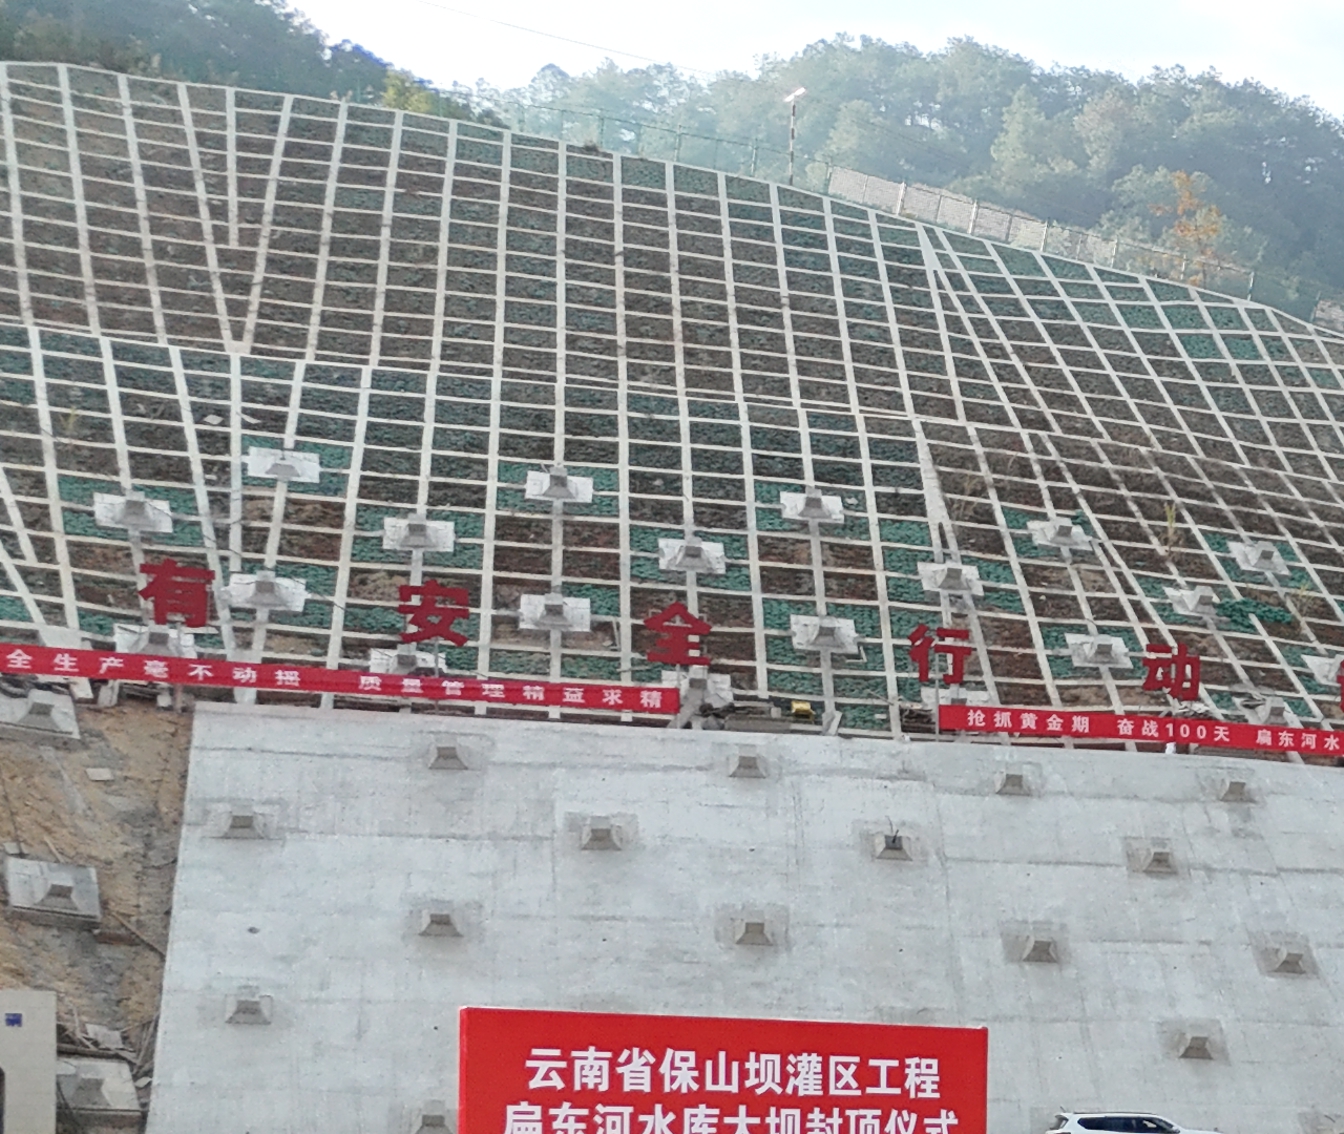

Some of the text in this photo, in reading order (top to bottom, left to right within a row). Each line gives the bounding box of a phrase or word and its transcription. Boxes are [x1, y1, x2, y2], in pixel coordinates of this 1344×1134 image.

[357, 675, 662, 709] 质量管理精益求精
[967, 709, 1090, 733] 抢抓黄金期
[1117, 718, 1230, 742] 奋战100天
[526, 1046, 941, 1099] 云南省保山坝灌区工程
